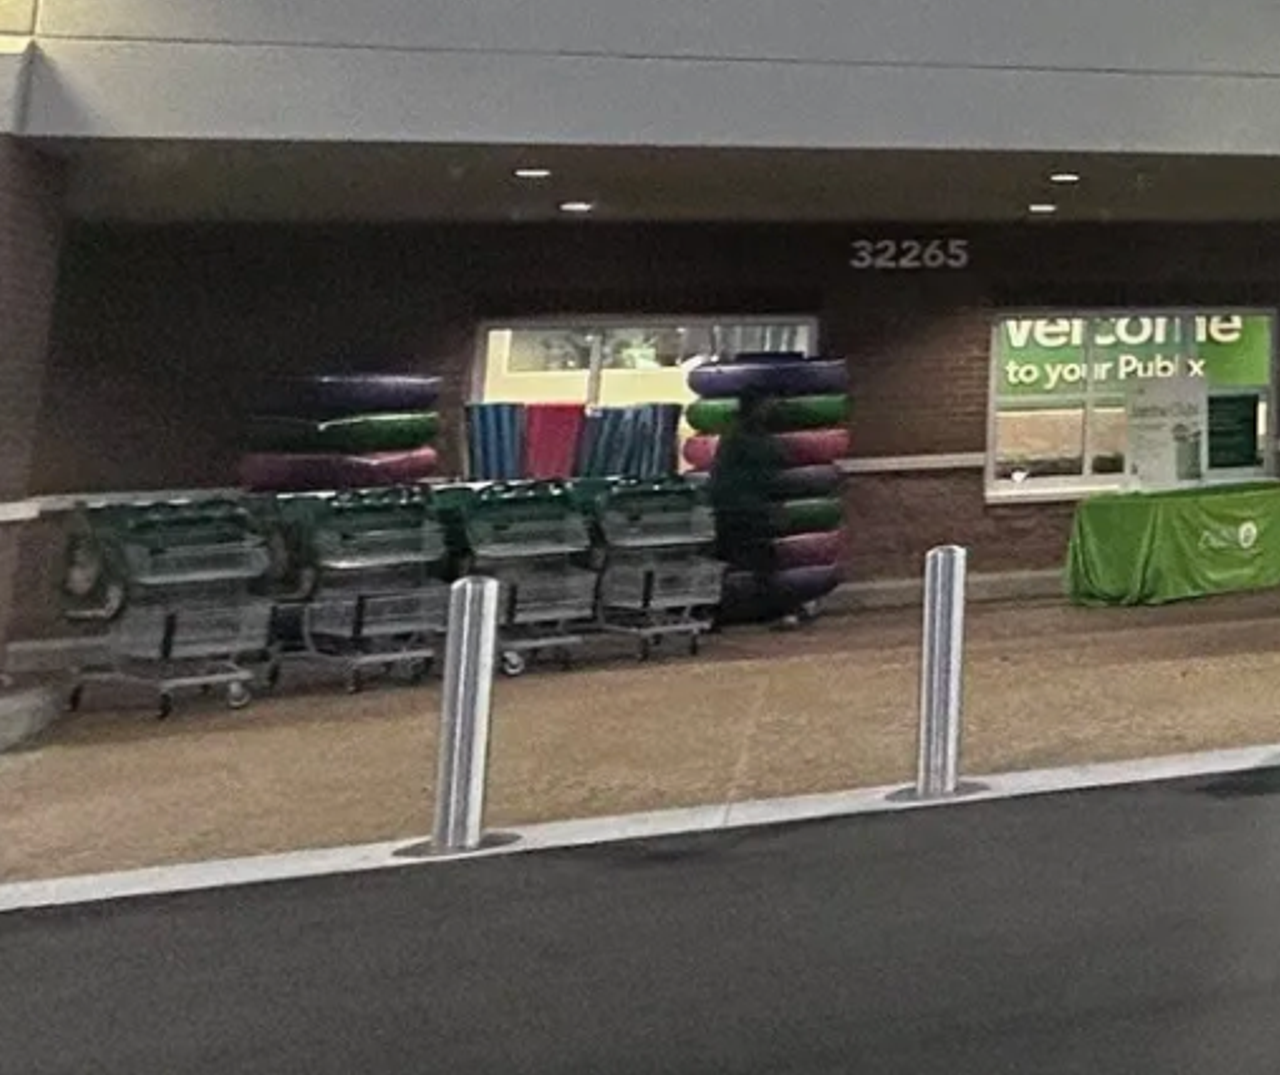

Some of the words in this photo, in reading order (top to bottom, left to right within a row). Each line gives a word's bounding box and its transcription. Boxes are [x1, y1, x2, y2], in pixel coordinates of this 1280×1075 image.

[850, 240, 969, 269] 32265
[1005, 359, 1039, 385] to
[1118, 354, 1205, 380] Pubx
